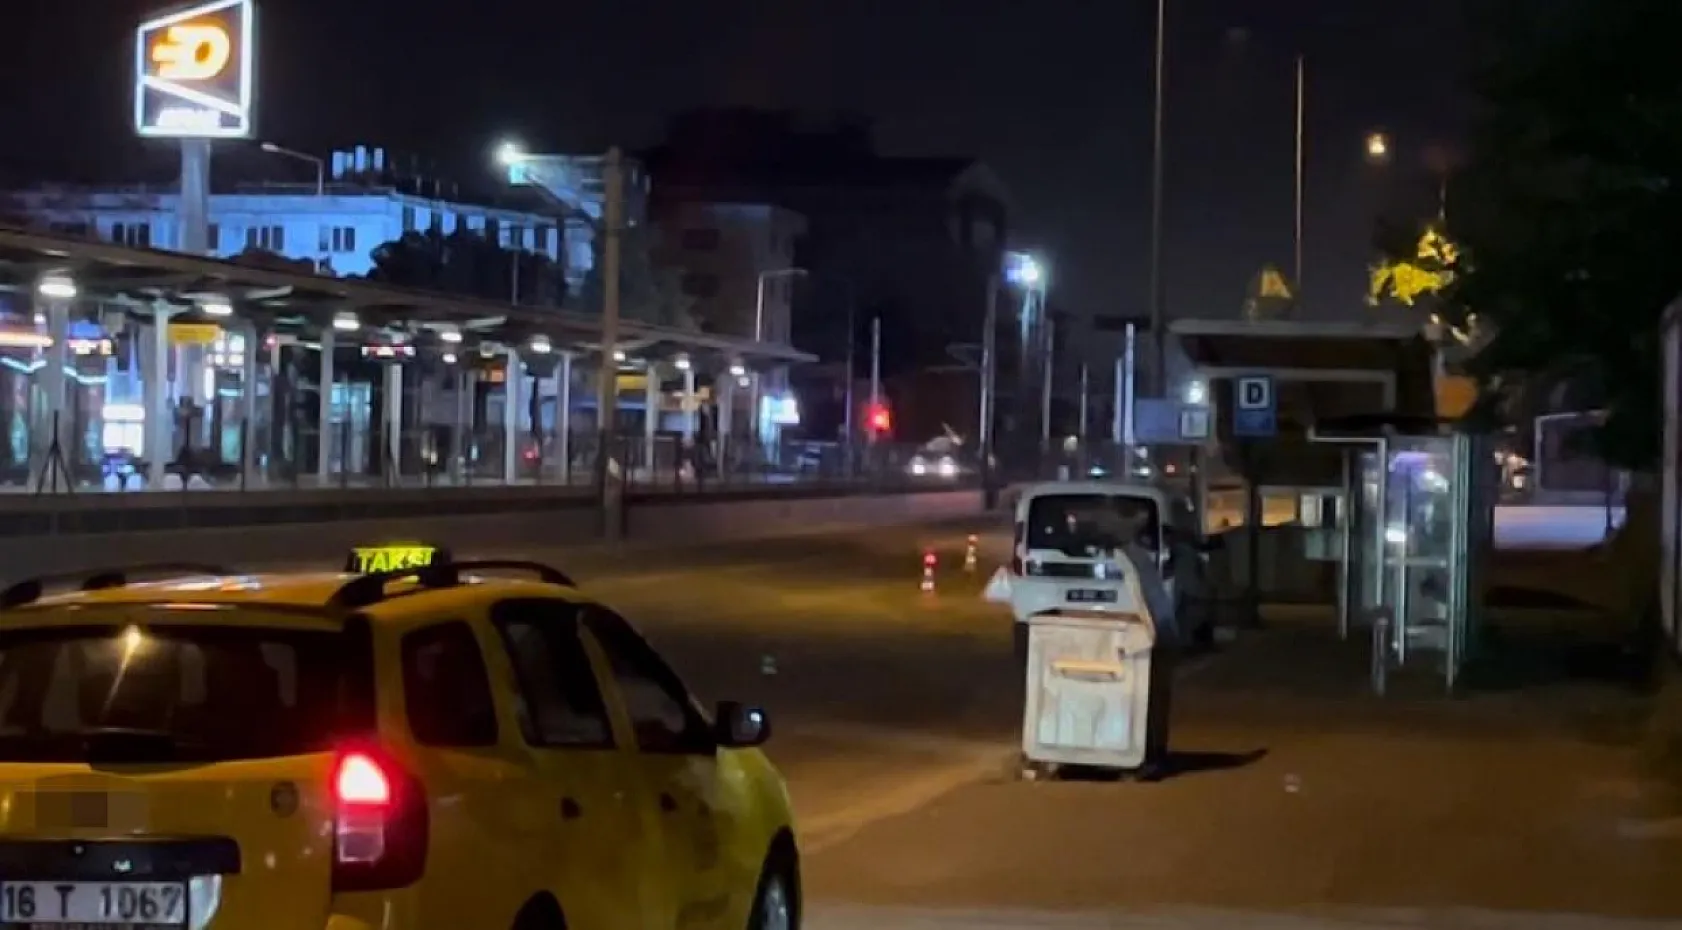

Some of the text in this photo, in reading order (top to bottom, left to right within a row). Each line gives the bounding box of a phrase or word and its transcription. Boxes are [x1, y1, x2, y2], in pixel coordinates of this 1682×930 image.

[1246, 381, 1264, 404] D
[5, 885, 182, 919] 16 T 1067
